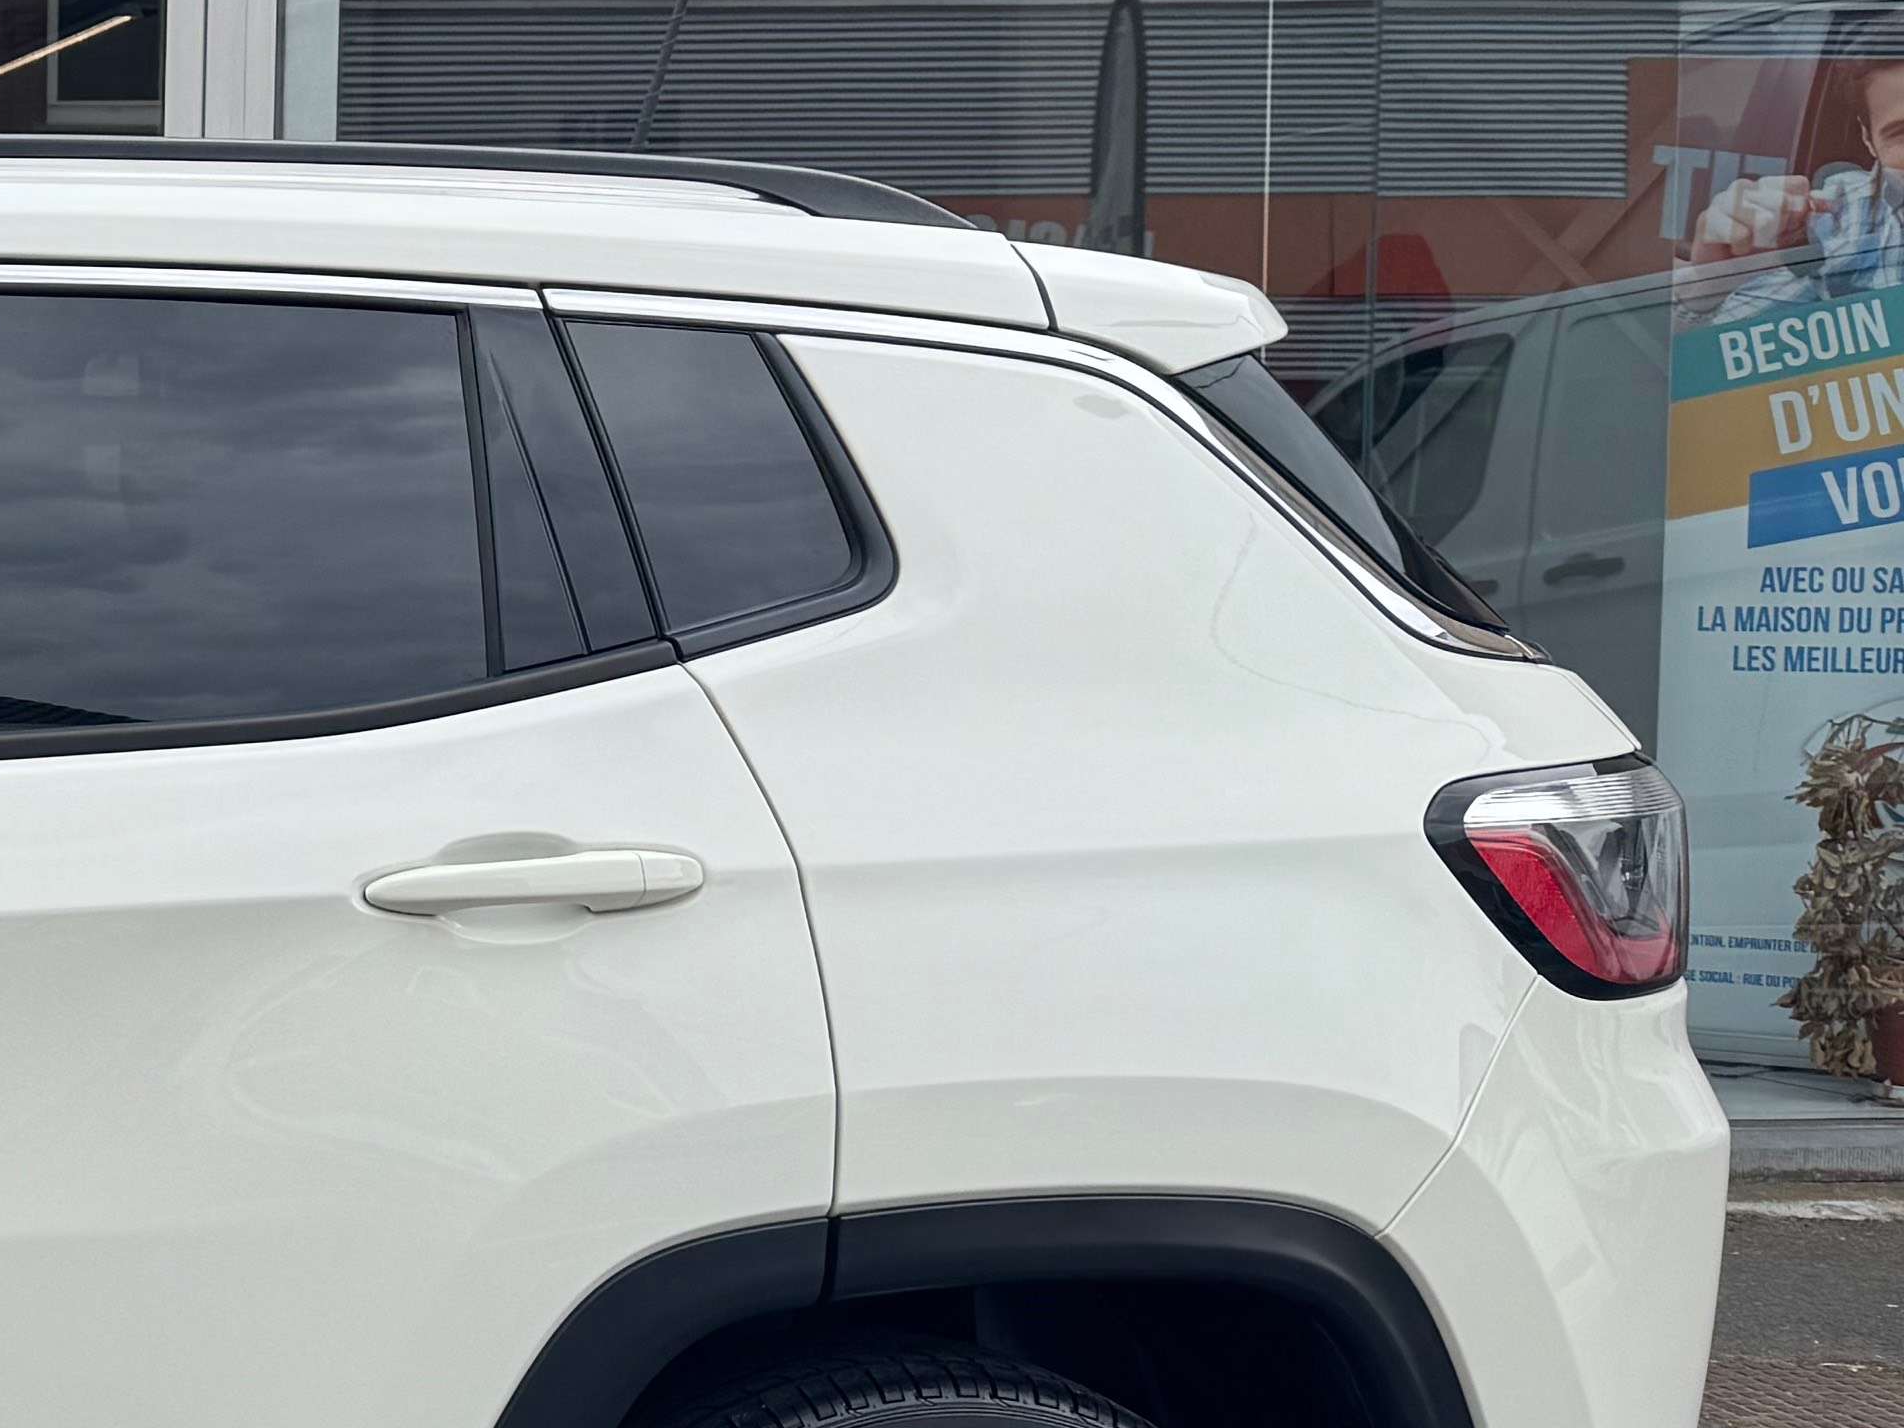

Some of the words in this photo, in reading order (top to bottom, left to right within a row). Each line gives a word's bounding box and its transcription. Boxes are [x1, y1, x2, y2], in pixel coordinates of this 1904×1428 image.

[1719, 298, 1890, 381] BESOIN
[1820, 456, 1904, 525] VO
[1760, 566, 1824, 593] AVEC
[1832, 566, 1865, 594] OU
[1873, 566, 1904, 594] SA
[1697, 606, 1726, 632] LA
[1734, 606, 1830, 632] MAISON
[1838, 606, 1872, 633] DU
[1732, 645, 1776, 672] LES
[1784, 646, 1904, 674] MEILLEUR
[1728, 935, 1792, 953] EMPRUNTER
[1699, 970, 1734, 984] SOCIAL
[1743, 973, 1764, 986] RUE
